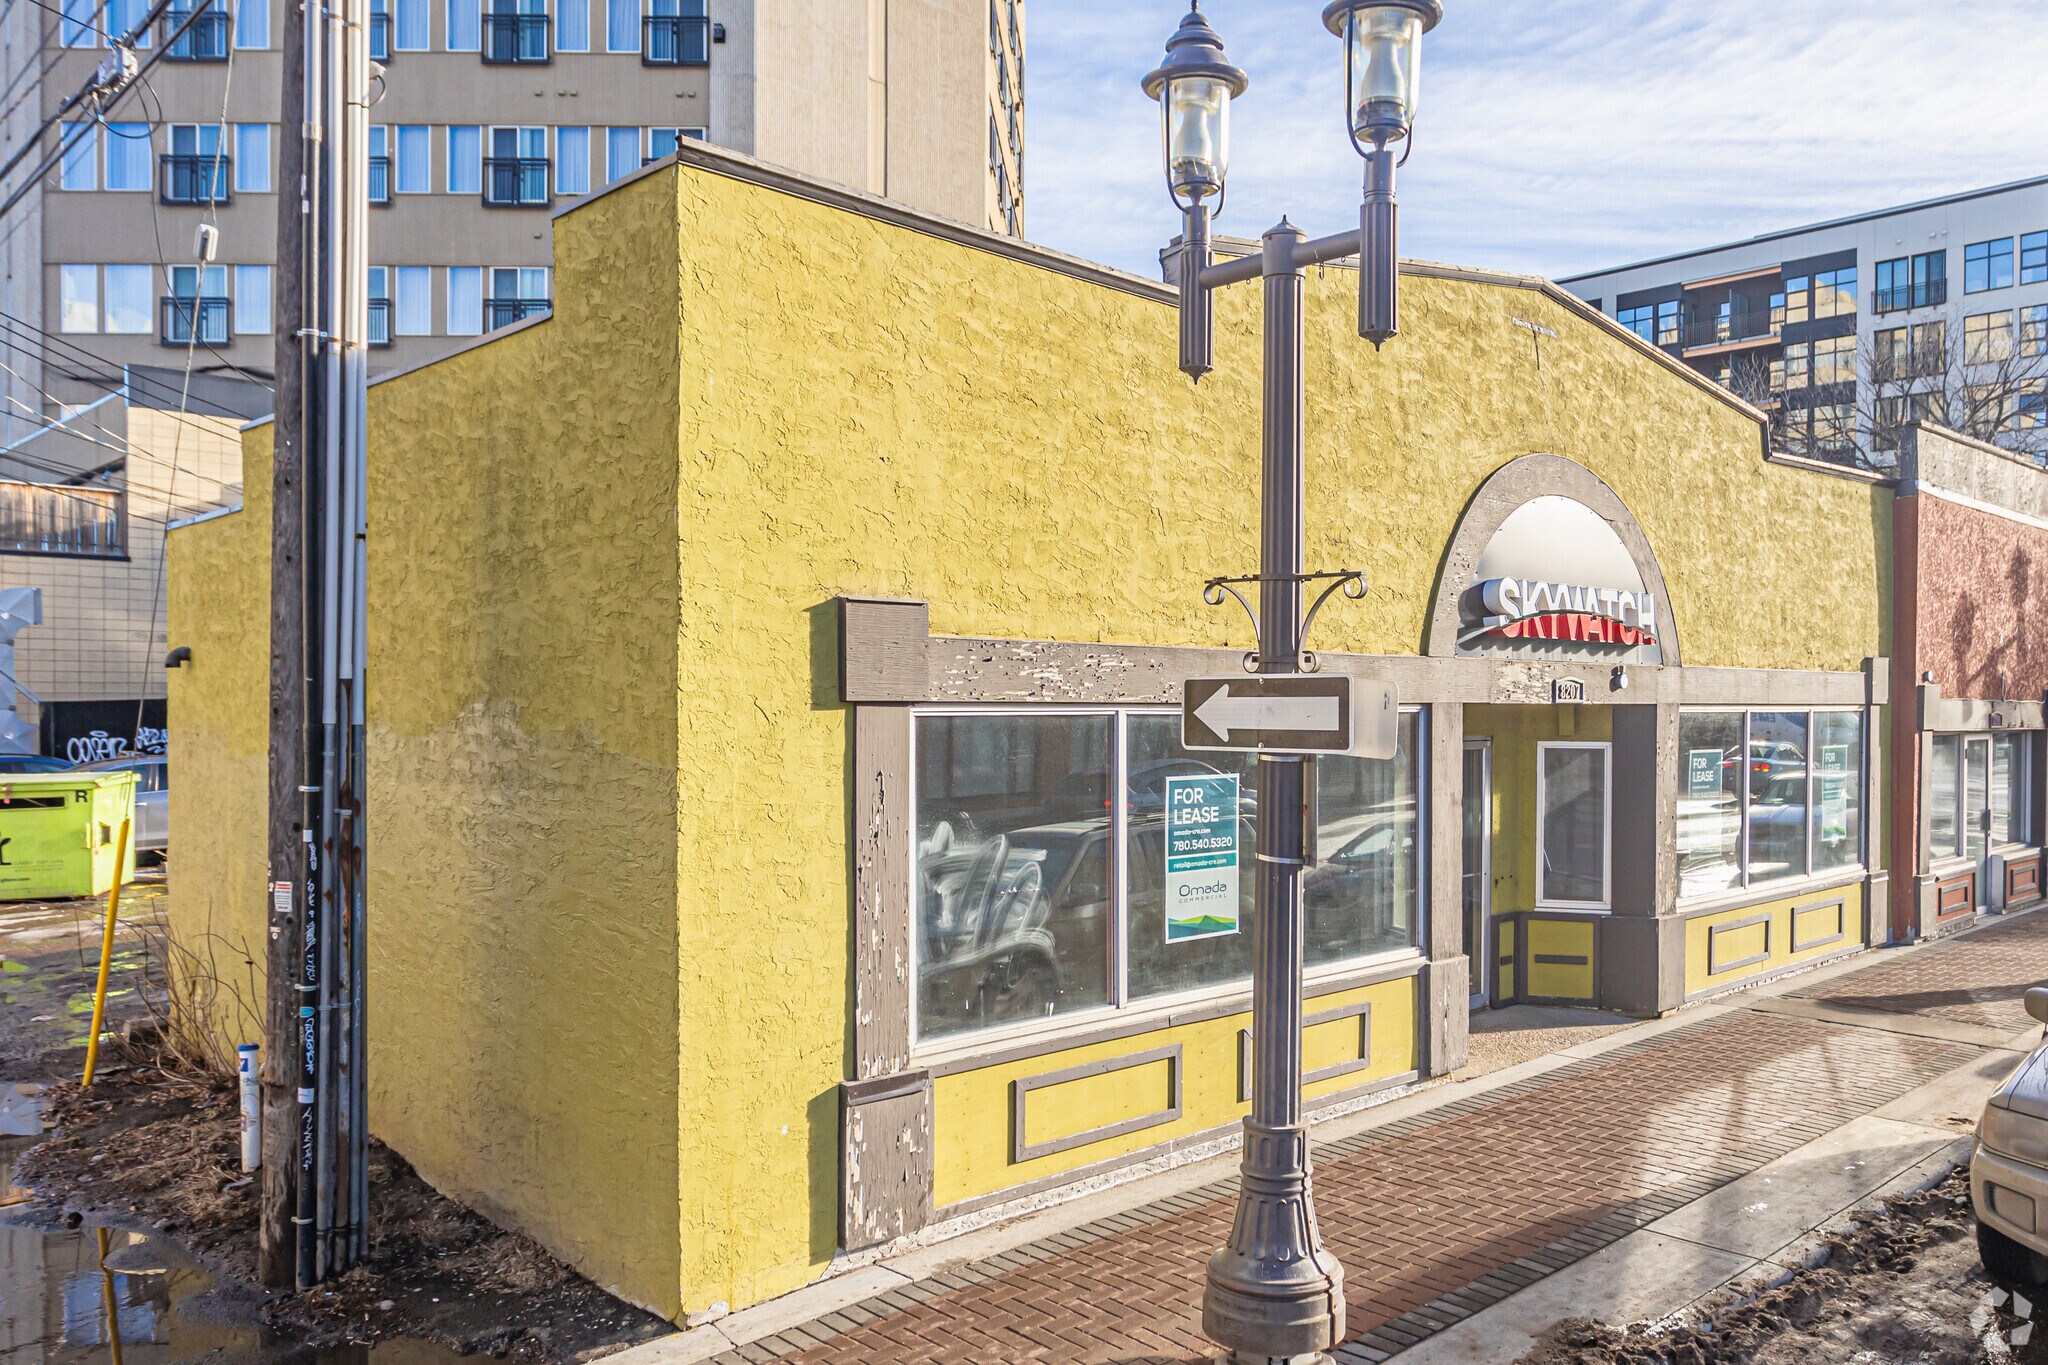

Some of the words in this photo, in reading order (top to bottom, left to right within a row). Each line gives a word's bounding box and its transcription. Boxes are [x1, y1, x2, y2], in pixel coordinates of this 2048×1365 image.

[1485, 576, 1656, 645] SKYWATCH
[1560, 684, 1580, 699] 8207
[1693, 757, 1707, 769] FOR
[1825, 752, 1836, 762] FOR
[1692, 770, 1714, 782] LEASE
[75, 790, 88, 803] R
[1174, 788, 1203, 805] FOR
[1173, 806, 1220, 825] LEASE
[1173, 828, 1211, 836] omada-cre.com
[1173, 836, 1233, 852] 780.540.5320
[1173, 859, 1227, 869] retail@omada-cre.com
[1179, 880, 1227, 897] Omada
[1179, 893, 1227, 904] COMMERCIAL
